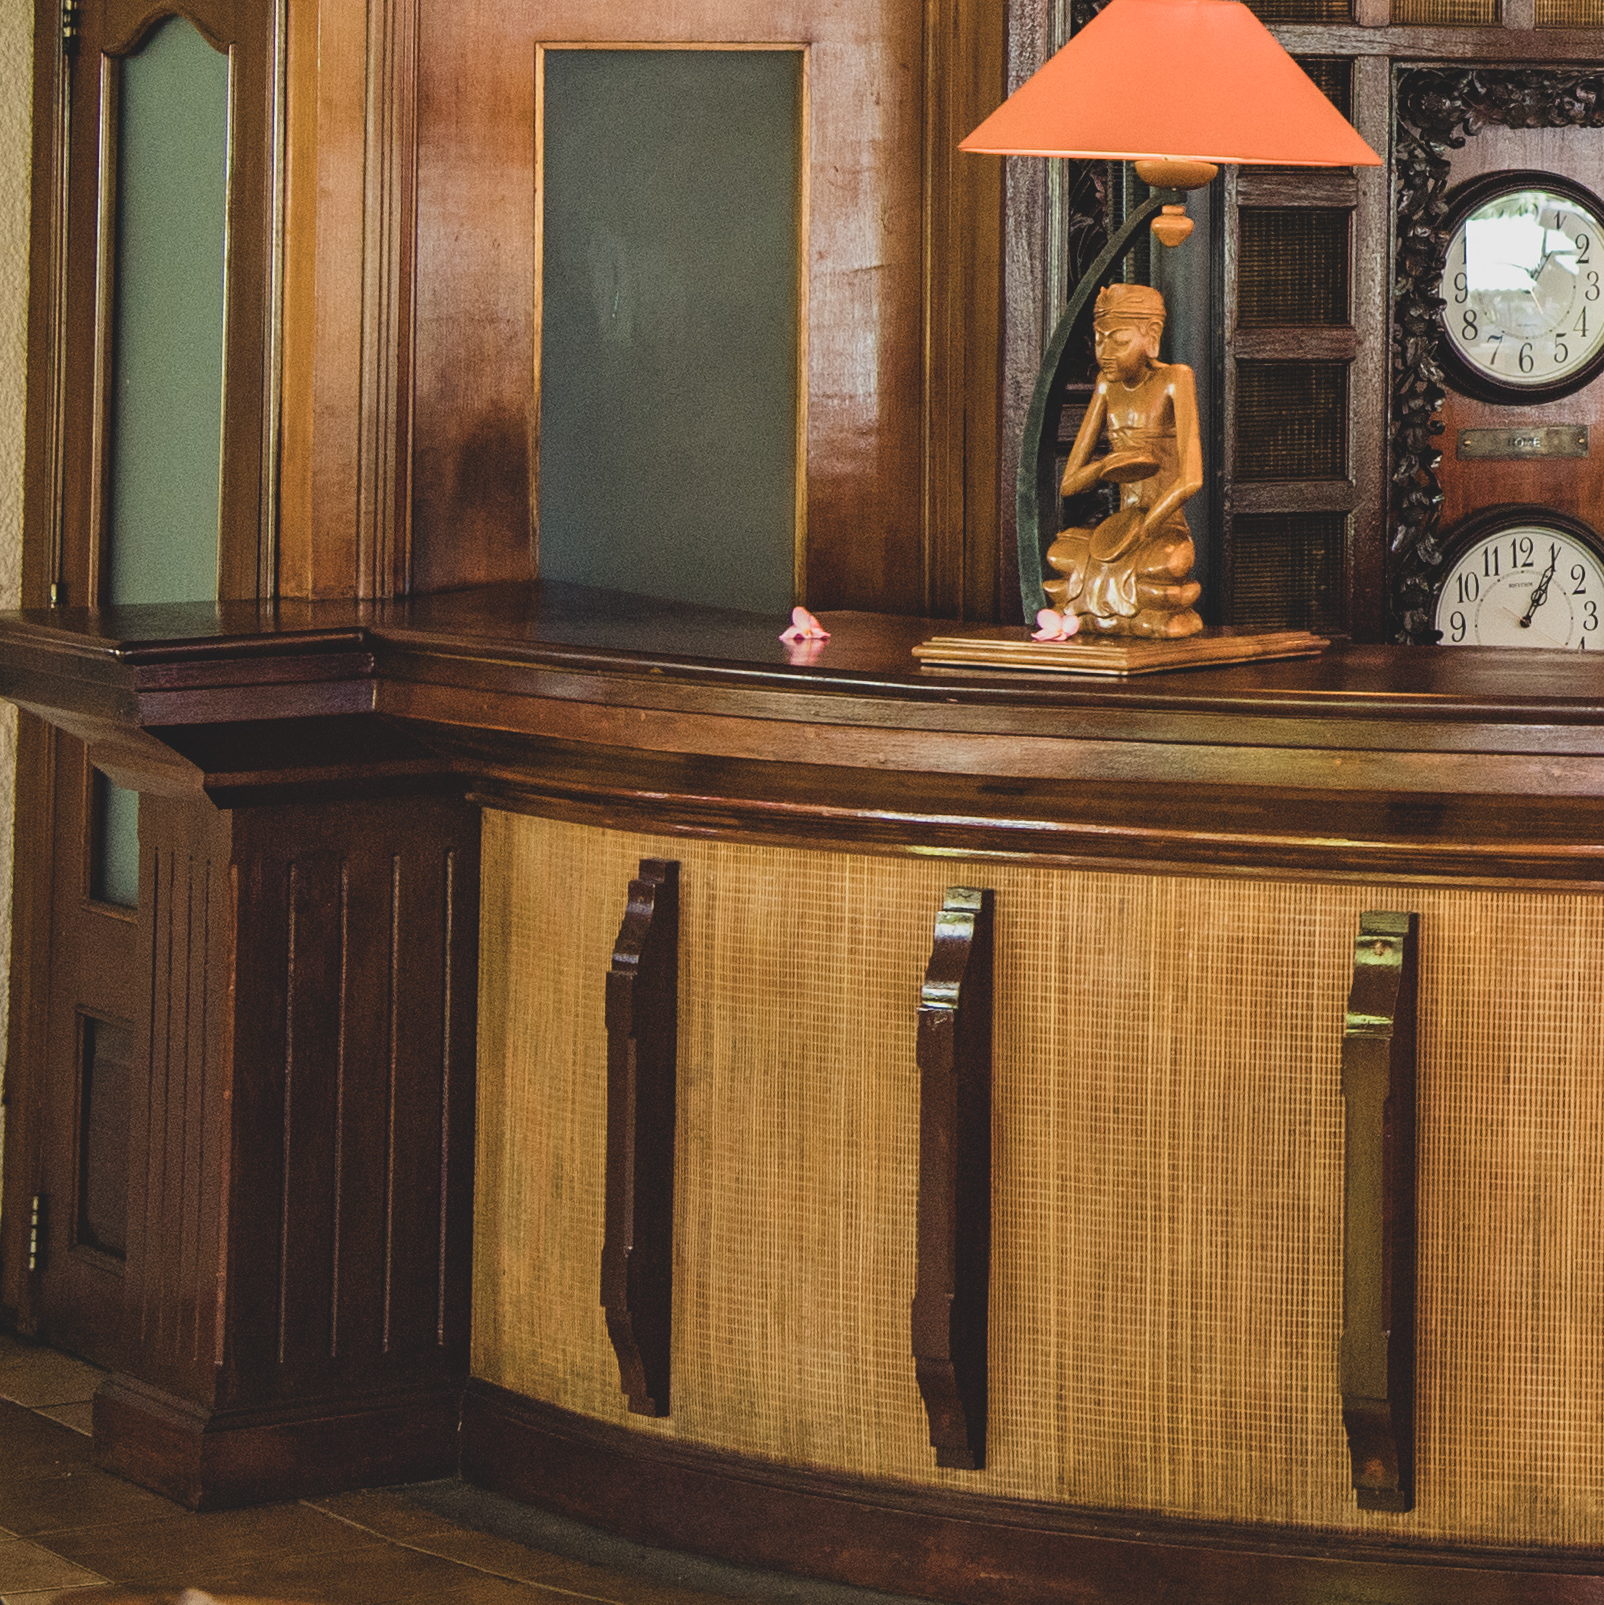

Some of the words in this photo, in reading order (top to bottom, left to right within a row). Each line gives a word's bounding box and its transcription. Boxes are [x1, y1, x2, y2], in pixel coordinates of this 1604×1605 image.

[1575, 234, 1590, 264] 2
[1454, 272, 1468, 304] 9
[1585, 271, 1601, 301] 3
[1461, 309, 1478, 340] 8
[1573, 306, 1589, 338] 4
[1487, 334, 1504, 365] 7
[1518, 342, 1534, 373] 6
[1553, 332, 1569, 364] 5
[1482, 546, 1500, 578] 11
[1510, 536, 1534, 569] 12
[1456, 571, 1480, 603] 10
[1570, 564, 1586, 595] 2
[1450, 610, 1466, 643] 9
[1583, 600, 1599, 632] 3
